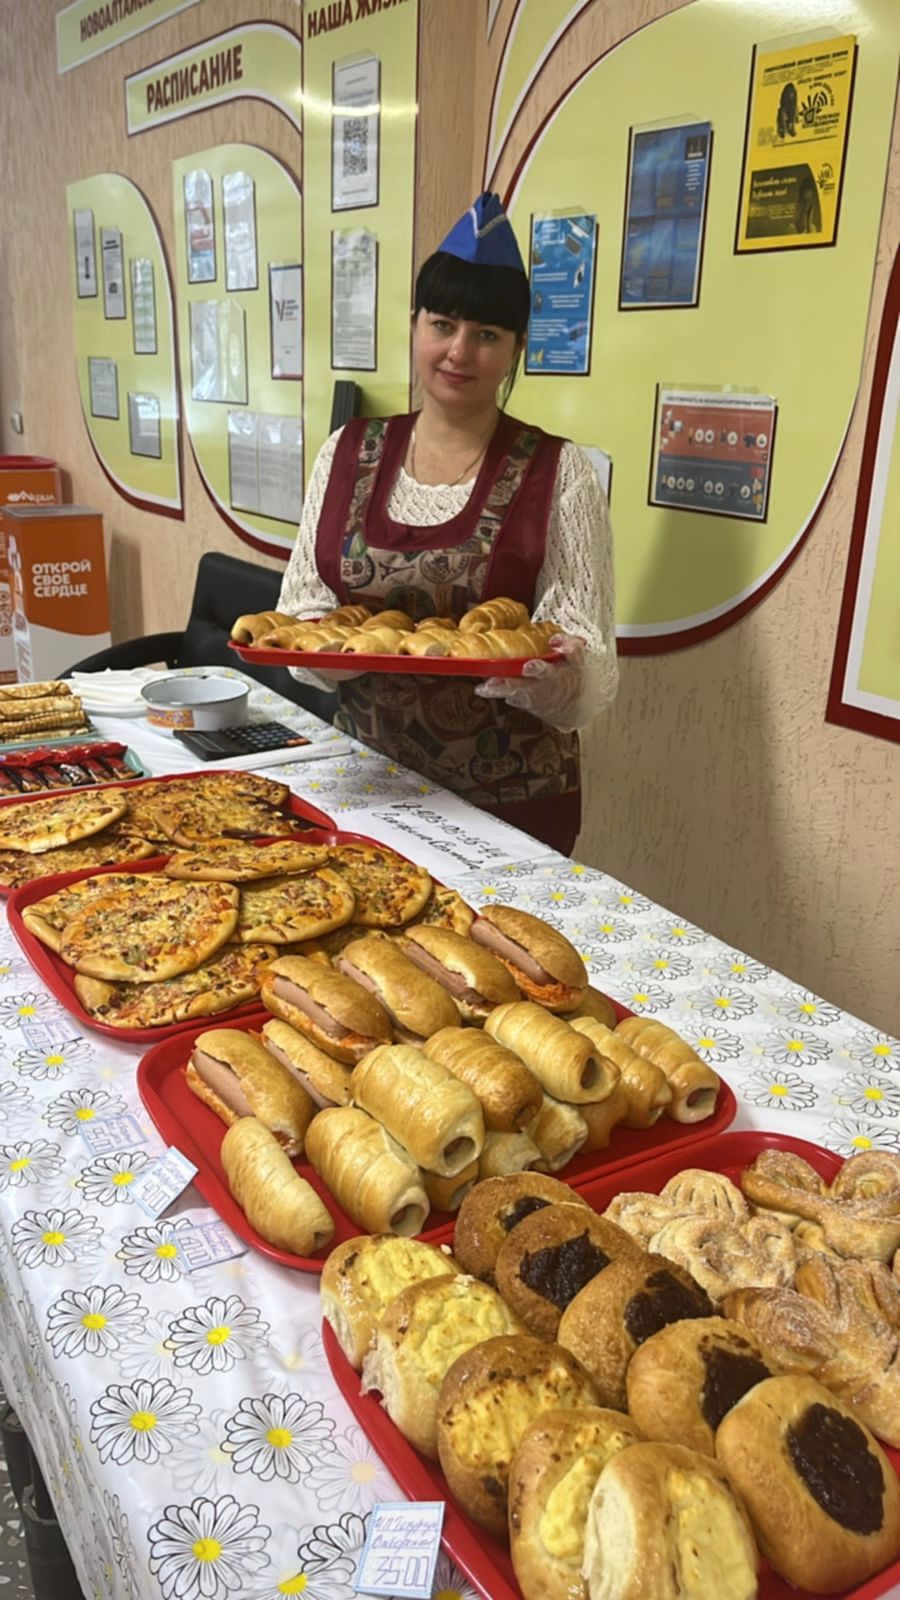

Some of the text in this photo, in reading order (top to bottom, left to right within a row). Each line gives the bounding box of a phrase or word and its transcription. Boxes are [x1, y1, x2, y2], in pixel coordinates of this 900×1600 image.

[80, 0, 155, 42] НОВОАЛТА
[308, 0, 353, 40] НАША
[146, 44, 243, 114] РАСПИСАНИЕ
[32, 559, 92, 575] ОТКРОЙ
[33, 574, 71, 586] СВОЕ
[34, 584, 89, 599] СЕРДЦЕ
